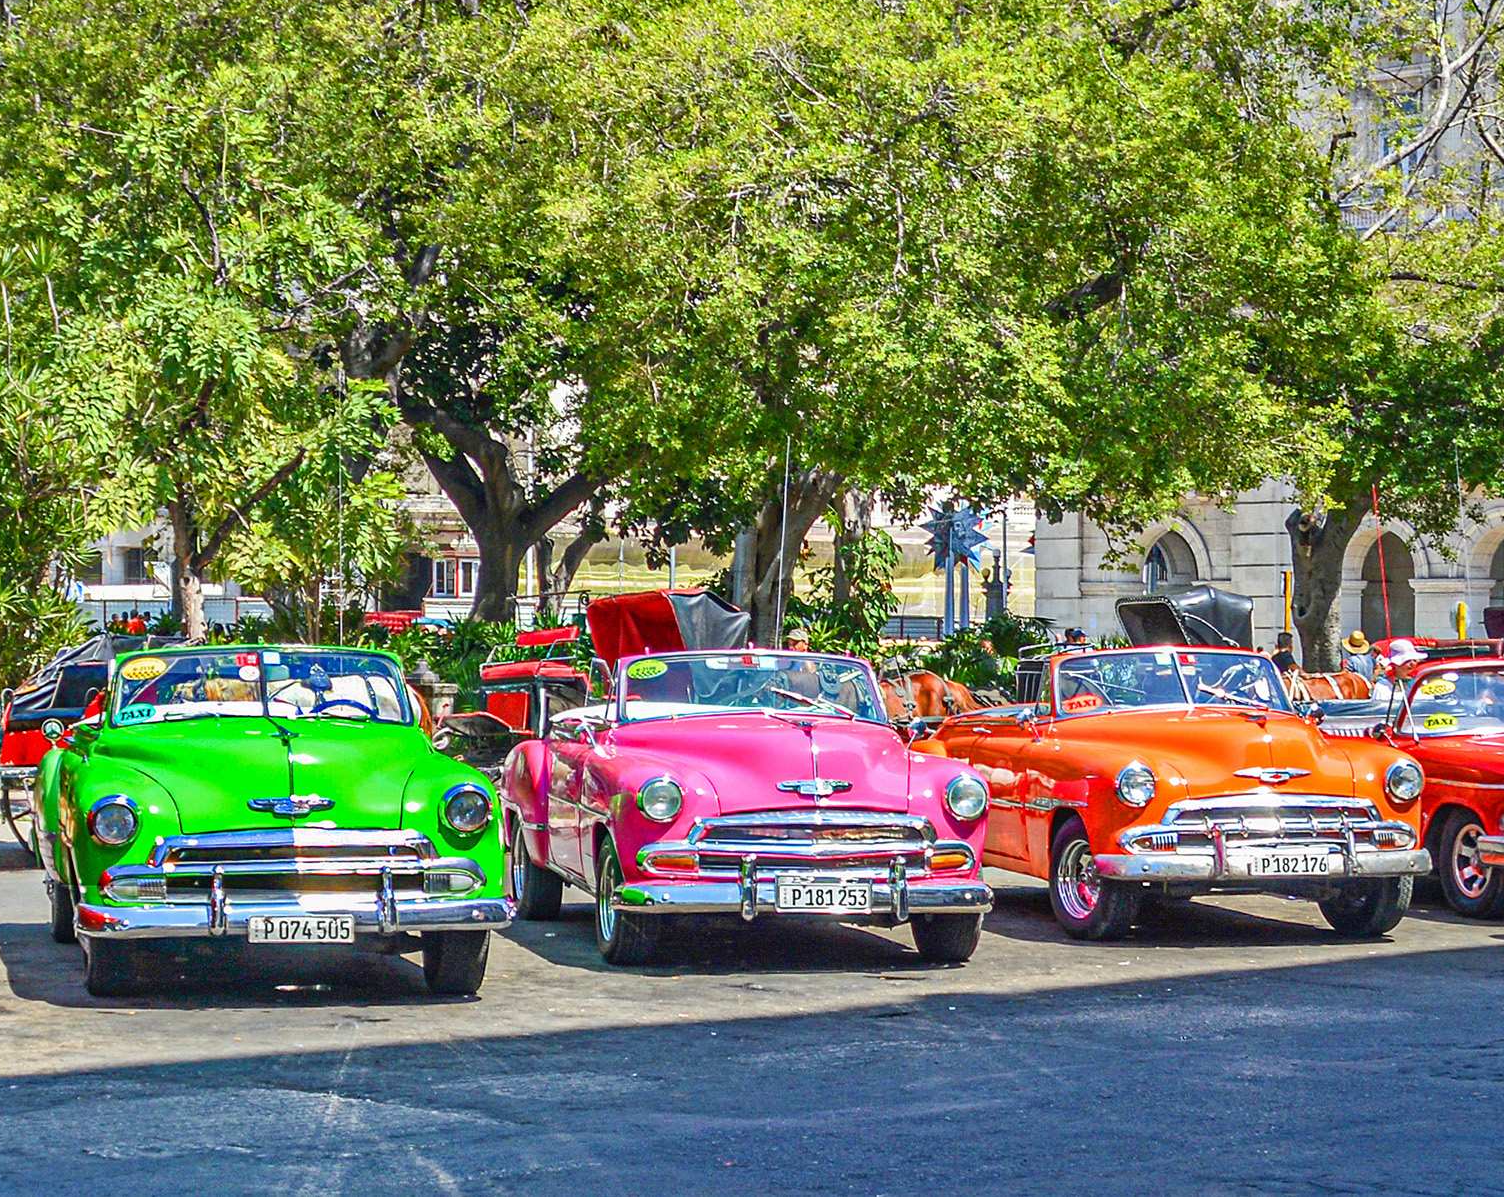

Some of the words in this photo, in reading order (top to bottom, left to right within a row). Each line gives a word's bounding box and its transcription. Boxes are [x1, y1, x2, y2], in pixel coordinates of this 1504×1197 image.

[1068, 699, 1096, 710] TAXI
[120, 709, 151, 722] TAXI
[1427, 717, 1453, 726] TAXI
[1261, 857, 1270, 874] P
[1273, 857, 1299, 873] 182
[1301, 856, 1327, 873] 176
[791, 888, 802, 906] P
[805, 889, 834, 906] 181
[838, 889, 867, 906] 253
[264, 920, 275, 940] P
[279, 920, 312, 940] 074
[316, 920, 350, 940] 505
